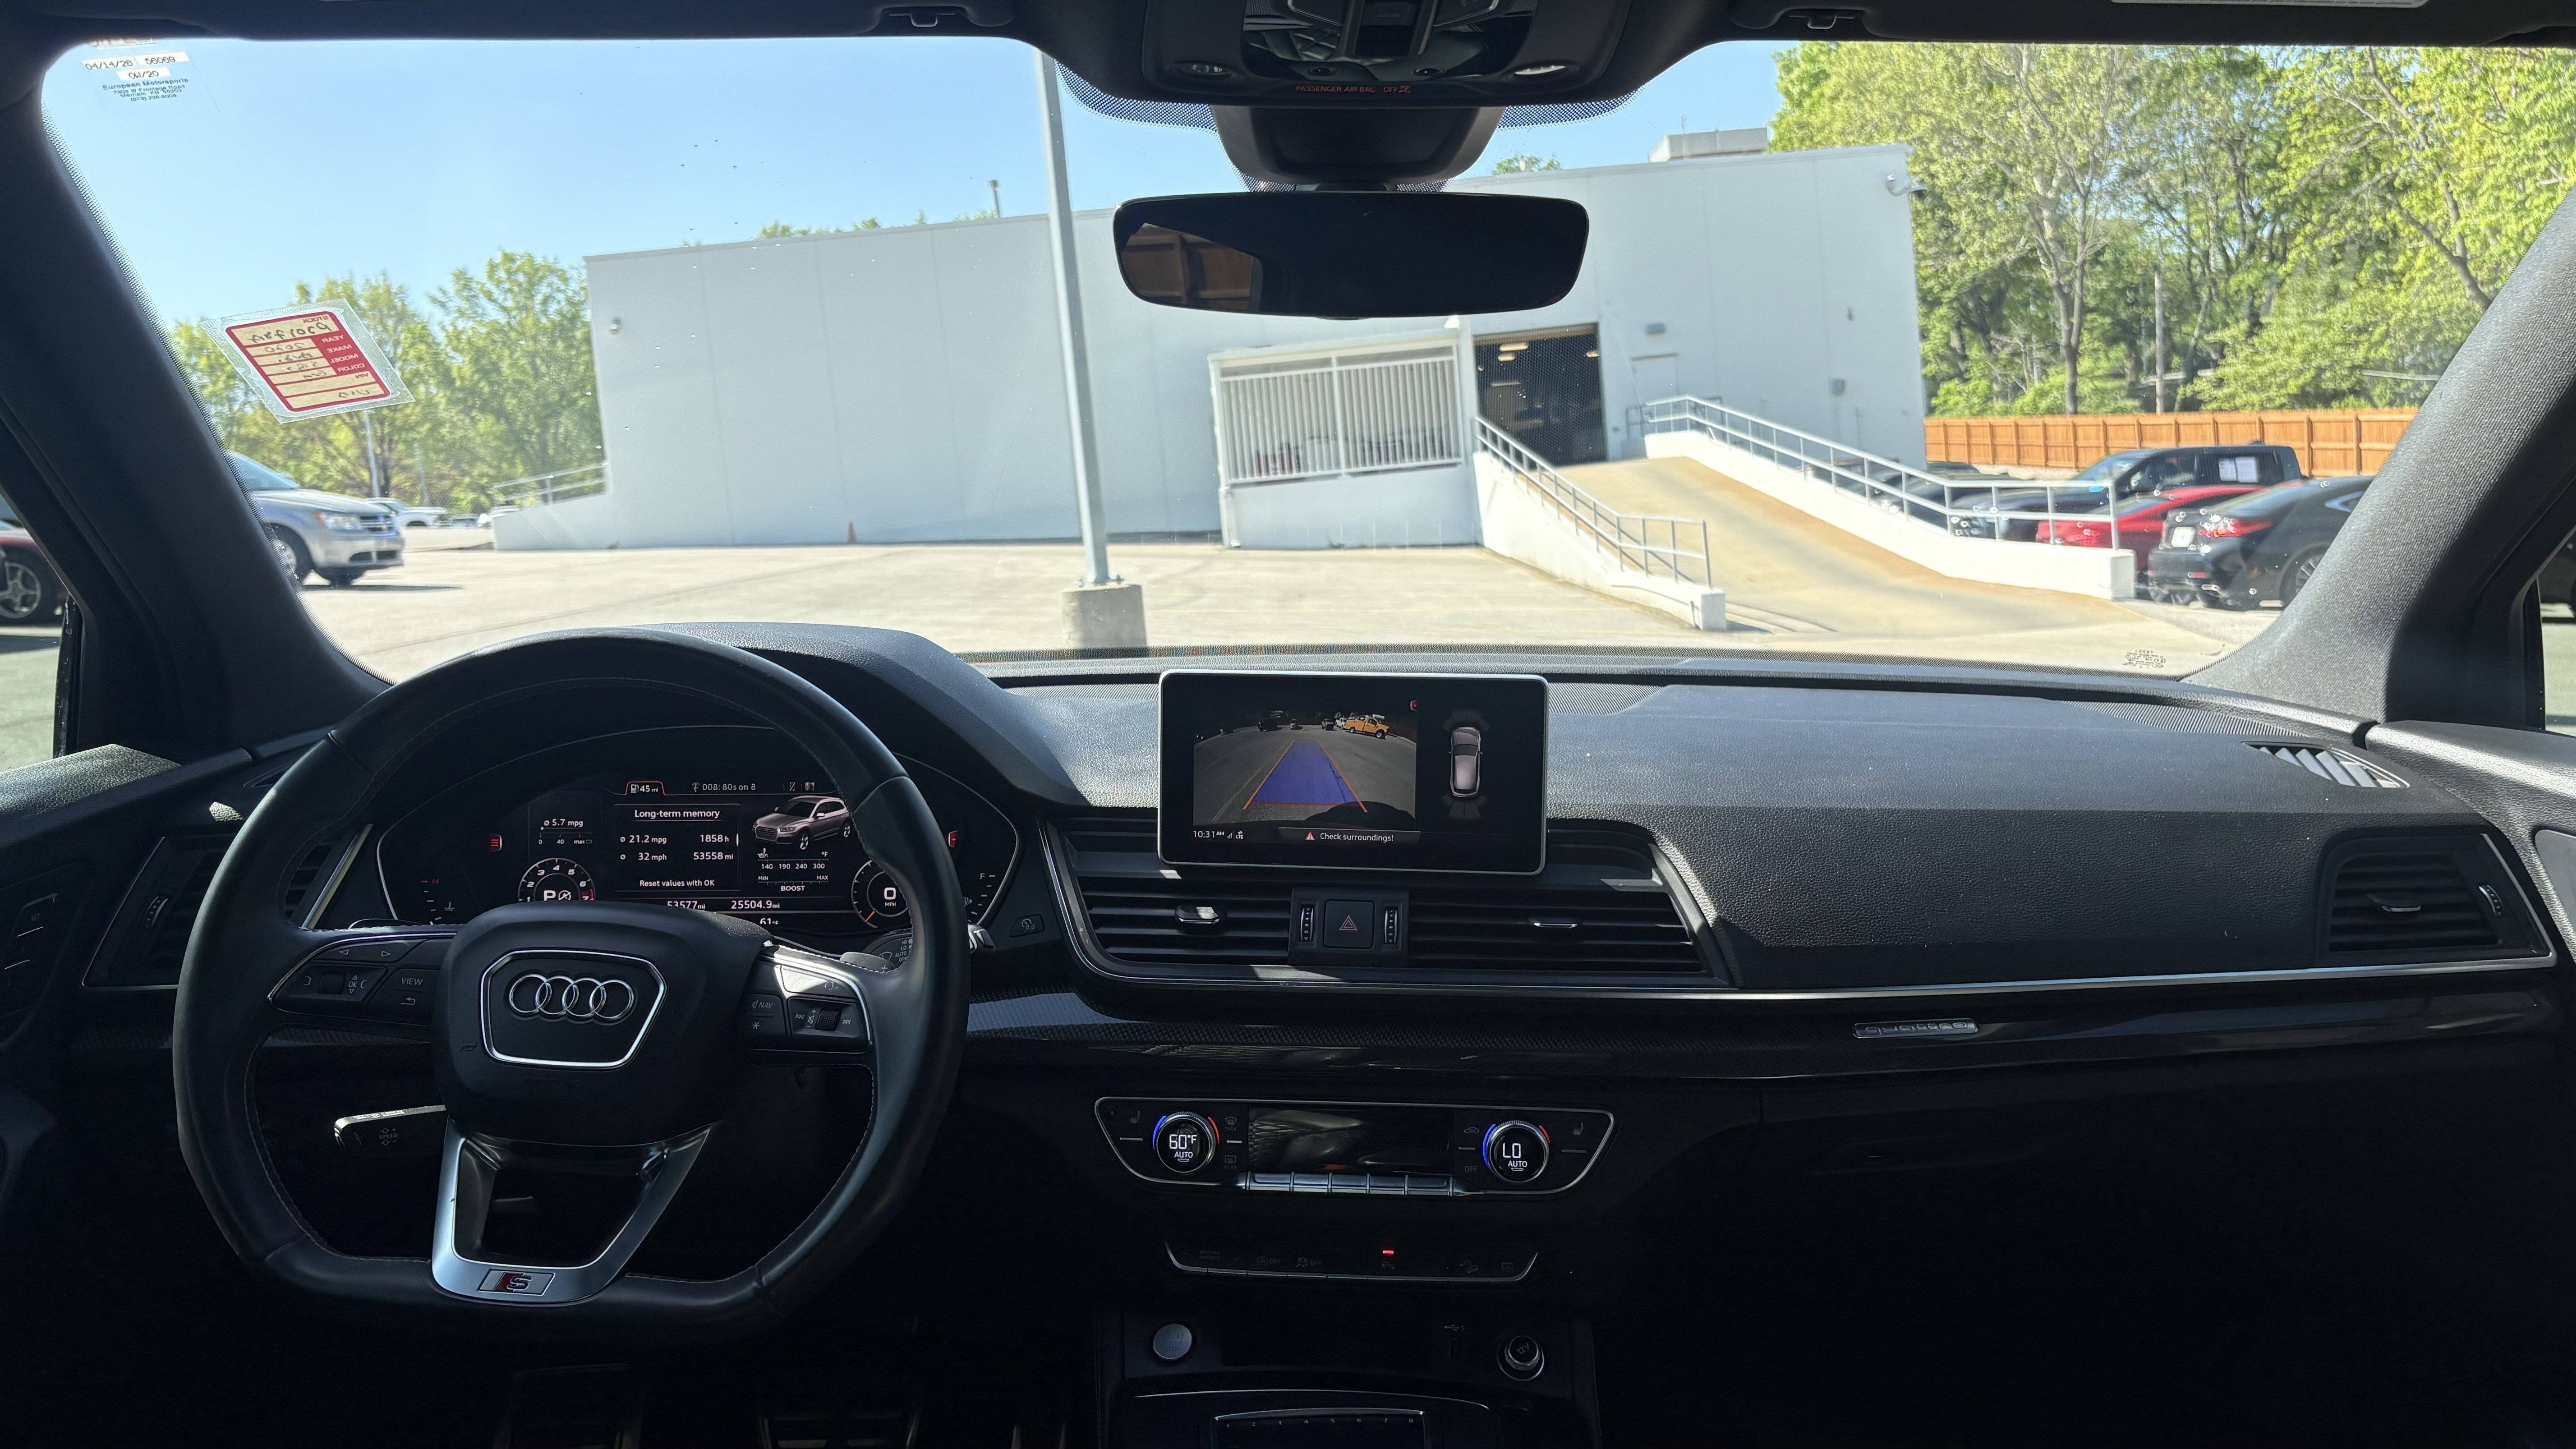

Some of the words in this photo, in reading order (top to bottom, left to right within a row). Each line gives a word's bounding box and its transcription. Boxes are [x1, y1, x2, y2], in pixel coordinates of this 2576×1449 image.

[102, 82, 141, 91] European
[635, 809, 681, 819] Long-term
[1193, 830, 1215, 838] 10:31
[1319, 832, 1342, 842] Check
[1343, 833, 1394, 844] surroundings!
[629, 835, 650, 843] 21.2
[651, 837, 667, 845] mpg
[699, 834, 723, 843] 1858
[638, 853, 650, 861] 32
[651, 854, 667, 862] mph
[693, 852, 723, 860] 53558
[686, 879, 703, 887] with
[543, 890, 556, 901] P
[883, 887, 897, 900] 0
[401, 977, 423, 986] VIEW
[1502, 1142, 1522, 1159] LO
[1516, 1342, 1530, 1355] 12V
